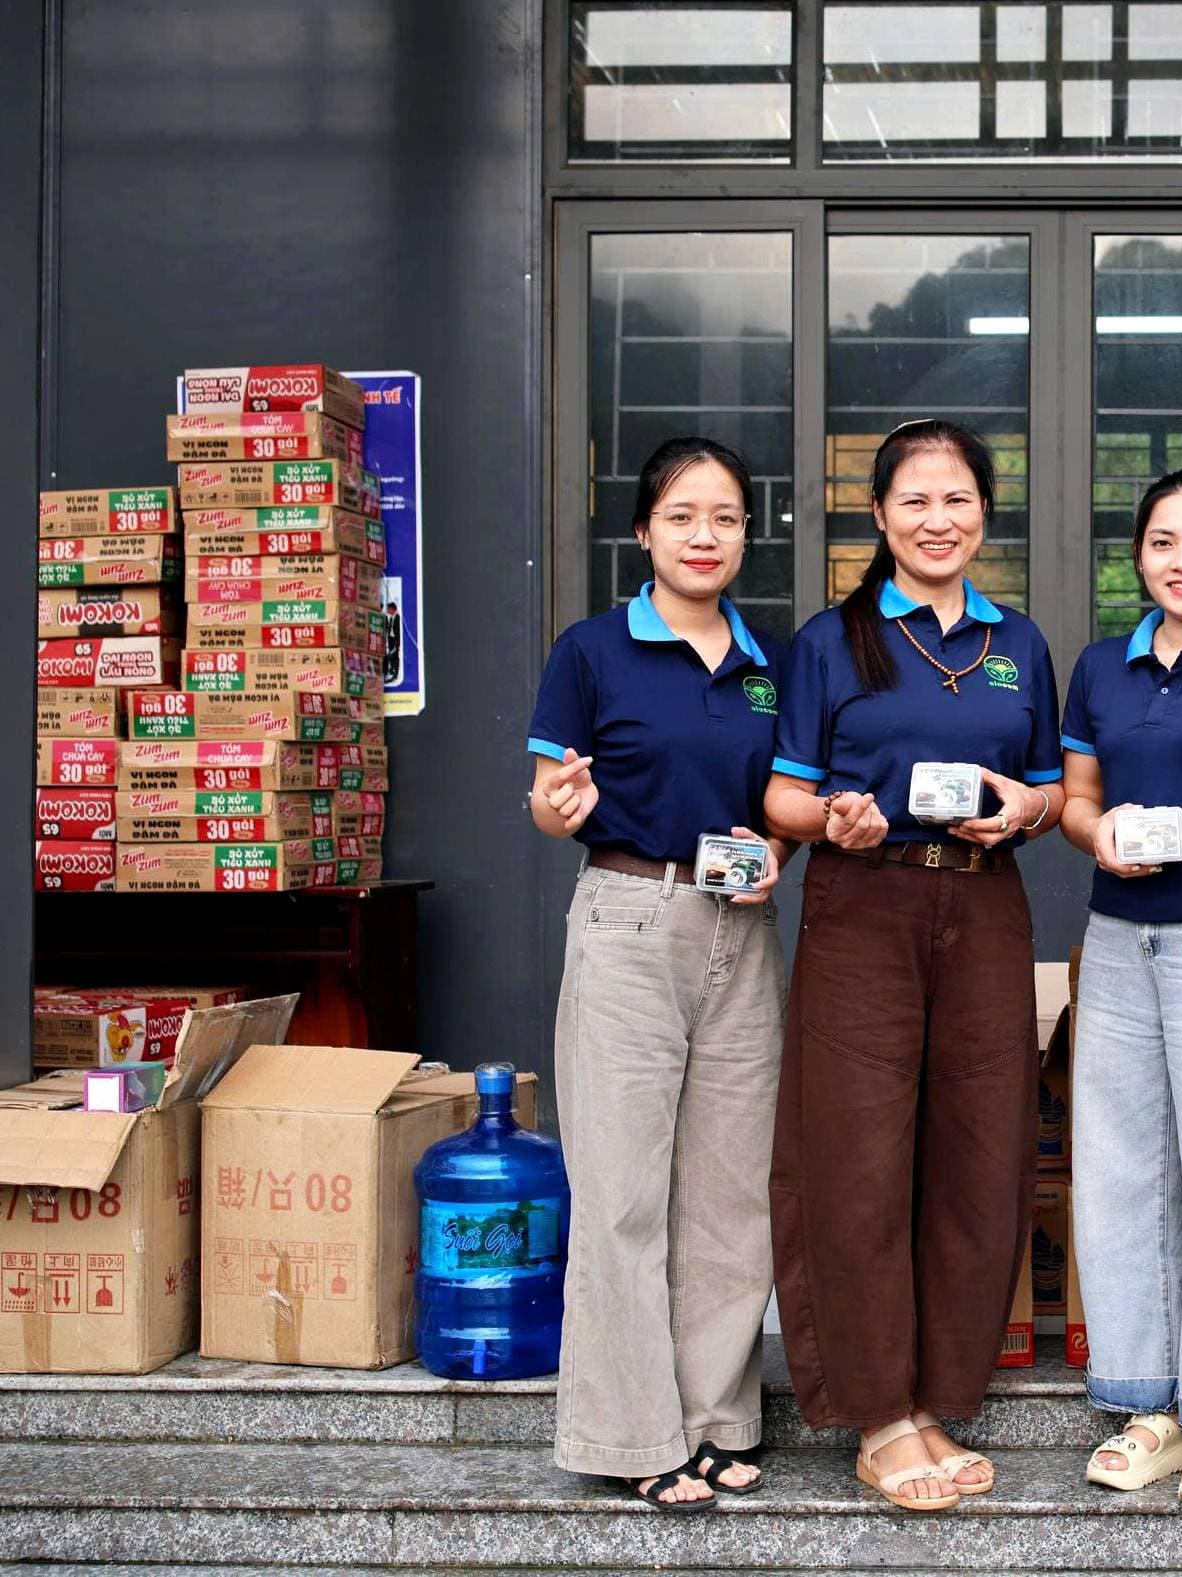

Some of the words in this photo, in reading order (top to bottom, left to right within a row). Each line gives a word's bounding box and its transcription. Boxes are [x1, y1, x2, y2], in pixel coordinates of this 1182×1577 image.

[248, 377, 318, 396] KOKOMI
[252, 401, 269, 412] 65
[254, 439, 274, 457] 30
[278, 438, 298, 450] gói
[282, 485, 302, 502] 30
[305, 484, 326, 494] gói
[117, 512, 138, 530] 30
[140, 511, 160, 522] gói
[54, 541, 75, 559] 30
[268, 534, 288, 552] 30
[291, 533, 311, 544] gói
[208, 566, 228, 577] gói
[231, 558, 252, 576] 30
[58, 602, 142, 625] KOKOMI
[271, 628, 292, 645] 30
[294, 627, 314, 637] gói
[75, 644, 91, 655] 65
[38, 658, 93, 677] OKOMI
[194, 661, 214, 671] gói
[217, 653, 238, 671] 30
[141, 703, 161, 714] gói
[165, 695, 186, 713] 30
[60, 764, 82, 782] 30
[204, 770, 226, 788] 30
[229, 769, 249, 780] gói
[39, 801, 111, 821] KOKOMI
[227, 805, 254, 813] XANH
[42, 823, 59, 835] 65
[207, 821, 229, 839] 30
[232, 820, 254, 831] gói
[40, 854, 113, 874] KOKOMI
[245, 859, 271, 867] XANH
[44, 877, 61, 887] 65
[223, 870, 245, 889] 30
[248, 869, 269, 880] gói
[147, 1015, 184, 1040] OKOMI
[149, 1042, 161, 1055] 65
[49, 1255, 75, 1267] 向上
